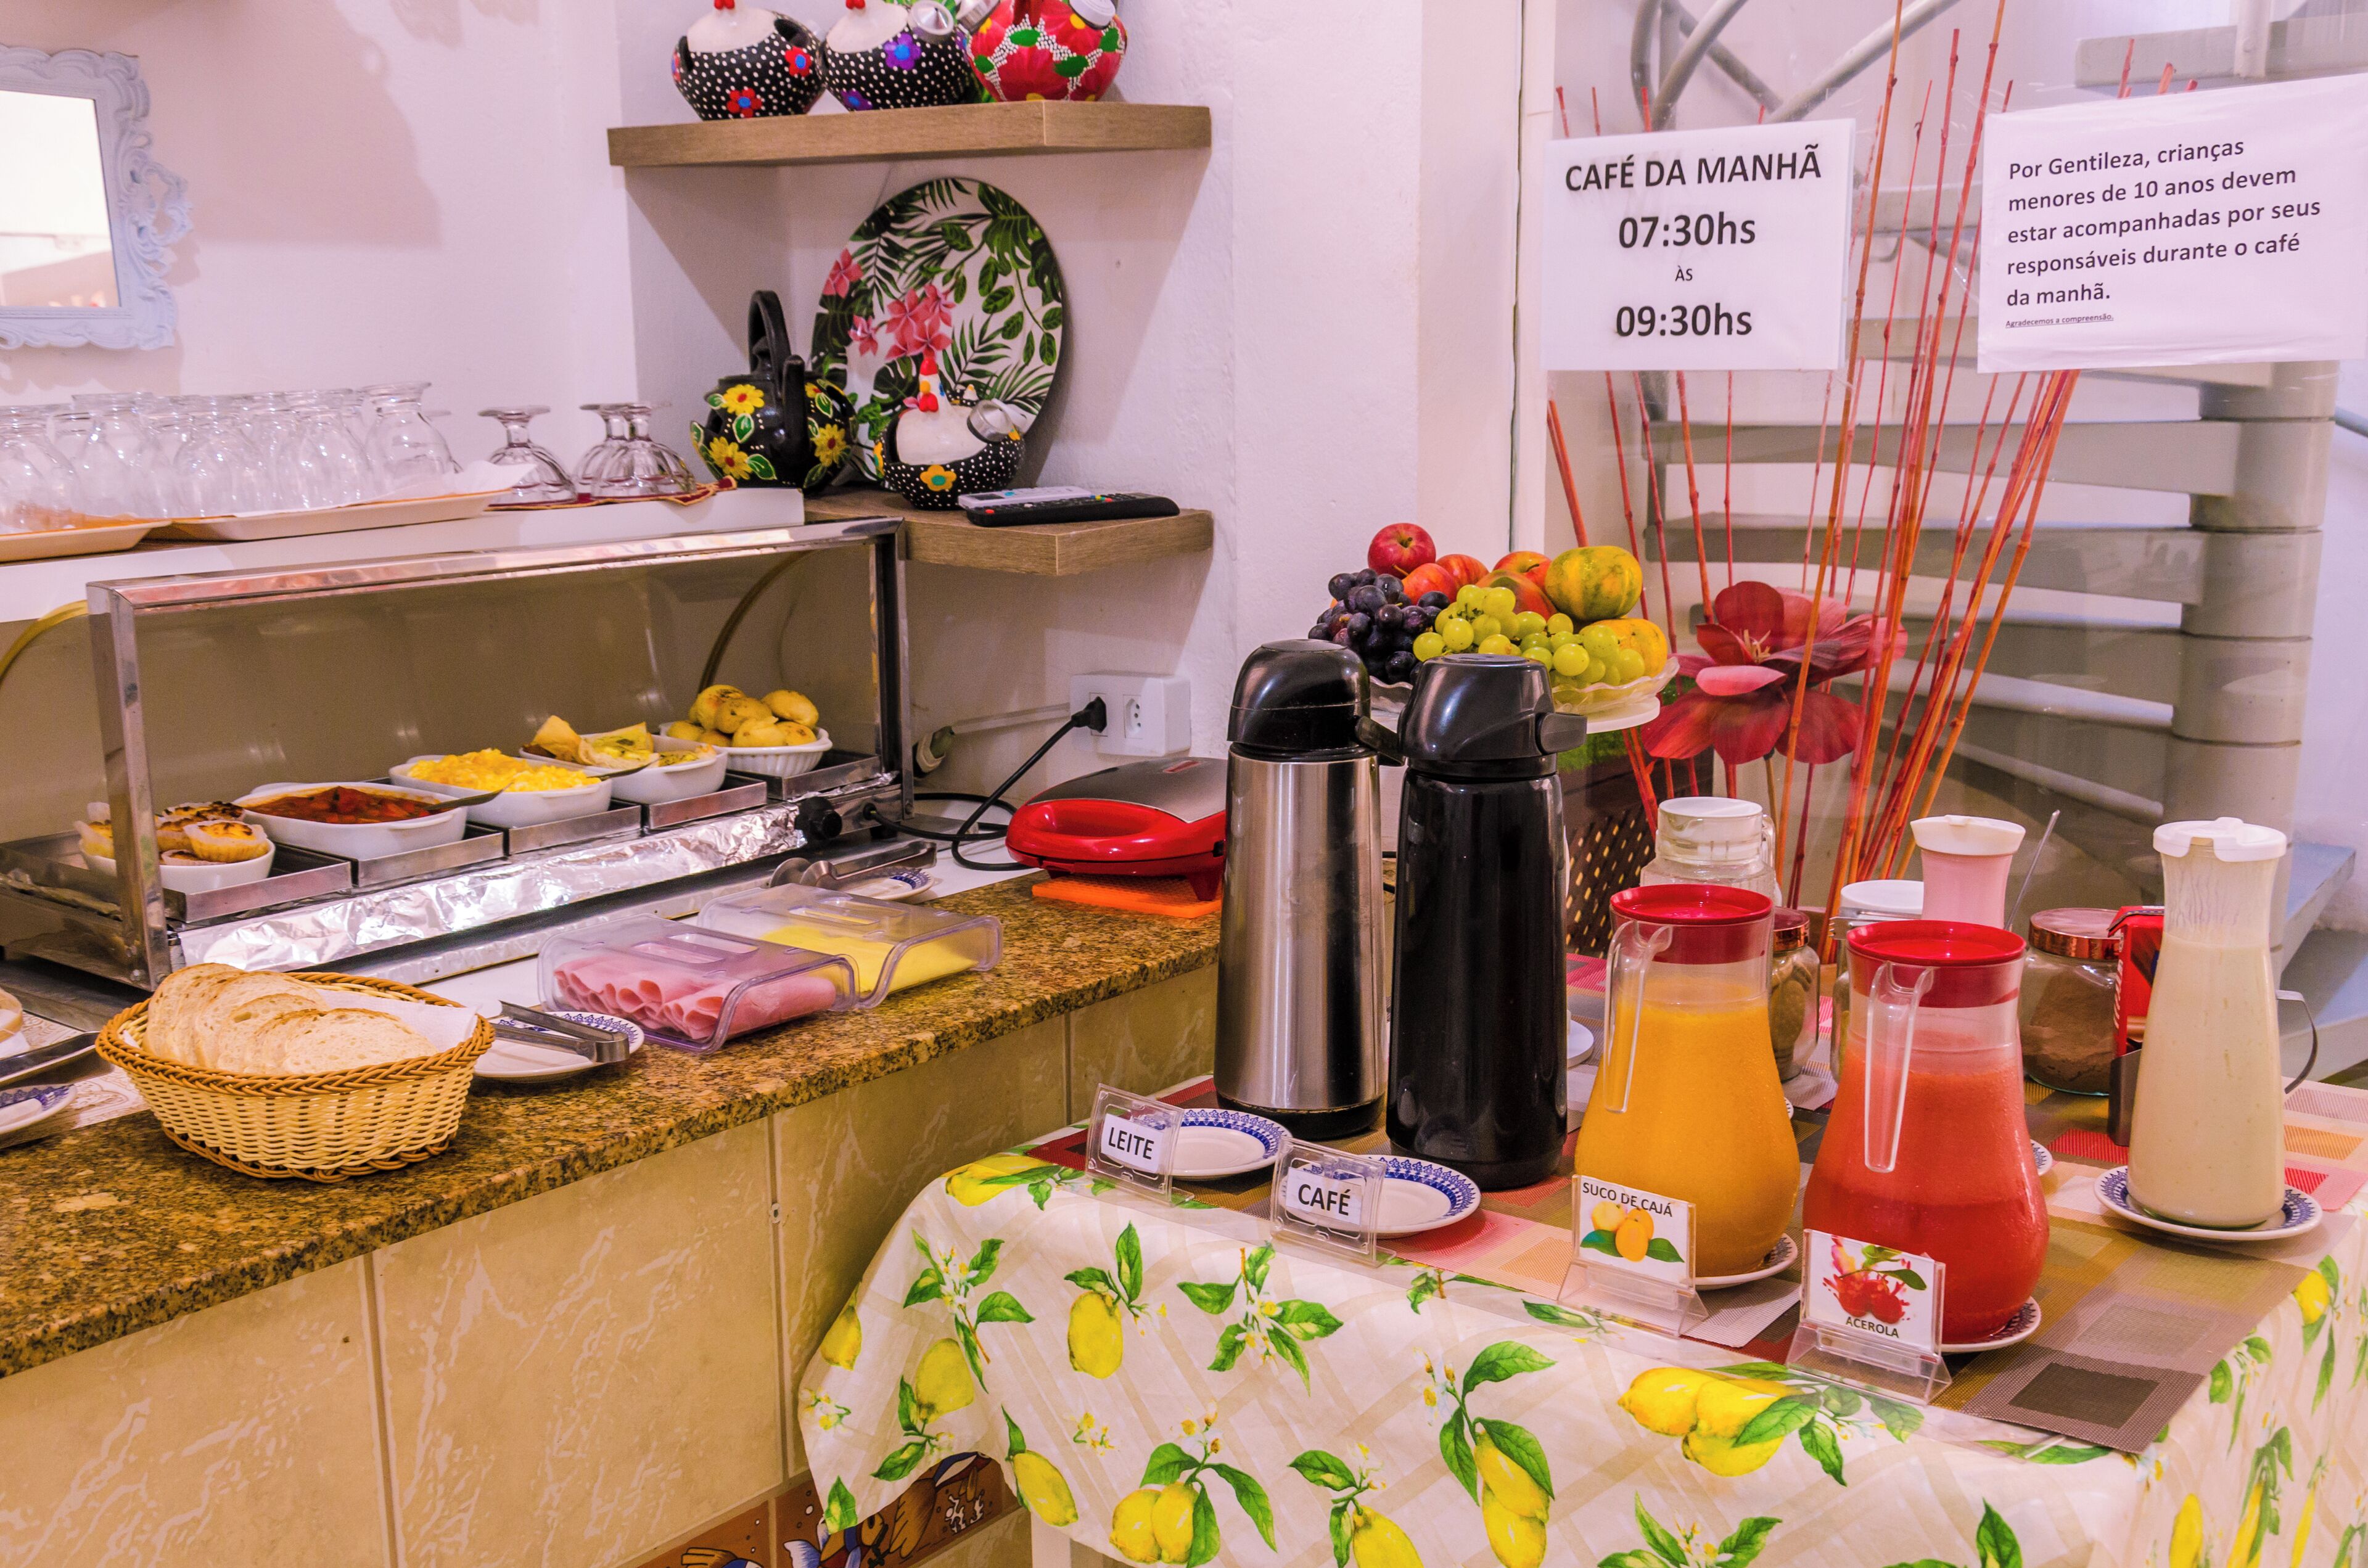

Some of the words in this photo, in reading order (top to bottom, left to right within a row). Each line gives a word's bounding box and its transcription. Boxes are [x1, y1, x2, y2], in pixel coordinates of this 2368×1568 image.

[1566, 155, 1634, 191] CAFÉ
[1645, 160, 1686, 187] DA
[1697, 143, 1822, 184] MANHÃ
[2009, 163, 2042, 179] Por
[2049, 152, 2150, 175] Gentileza,
[2157, 141, 2244, 163] crianças
[2009, 191, 2094, 211] menores
[2102, 184, 2126, 202] de
[2134, 181, 2158, 199] 10
[2165, 178, 2214, 195] anos
[2222, 168, 2296, 190] devem
[1619, 211, 1756, 248] 07:30hs
[2008, 225, 2057, 243] estar
[2063, 209, 2220, 237] acompanhadas
[2227, 206, 2264, 227] por
[2272, 200, 2321, 219] seus
[2007, 248, 2136, 276] responsáveis
[2144, 243, 2227, 264] durante
[2235, 240, 2247, 255] o
[2255, 233, 2300, 254] café
[1675, 265, 1693, 281] ÀS
[2007, 290, 2029, 306] da
[2036, 283, 2110, 303] manhã.
[1616, 303, 1752, 337] 09:30hs
[2005, 318, 2054, 328] Agradecemos
[2062, 313, 2114, 323] compreensão.
[1108, 1127, 1154, 1160] LEITE
[1298, 1184, 1350, 1216] CAFÉ
[1582, 1183, 1616, 1201] SUCO
[1621, 1193, 1638, 1207] DE
[1642, 1199, 1672, 1217] CAJÁ
[1846, 1316, 1899, 1337] ACEROLA
